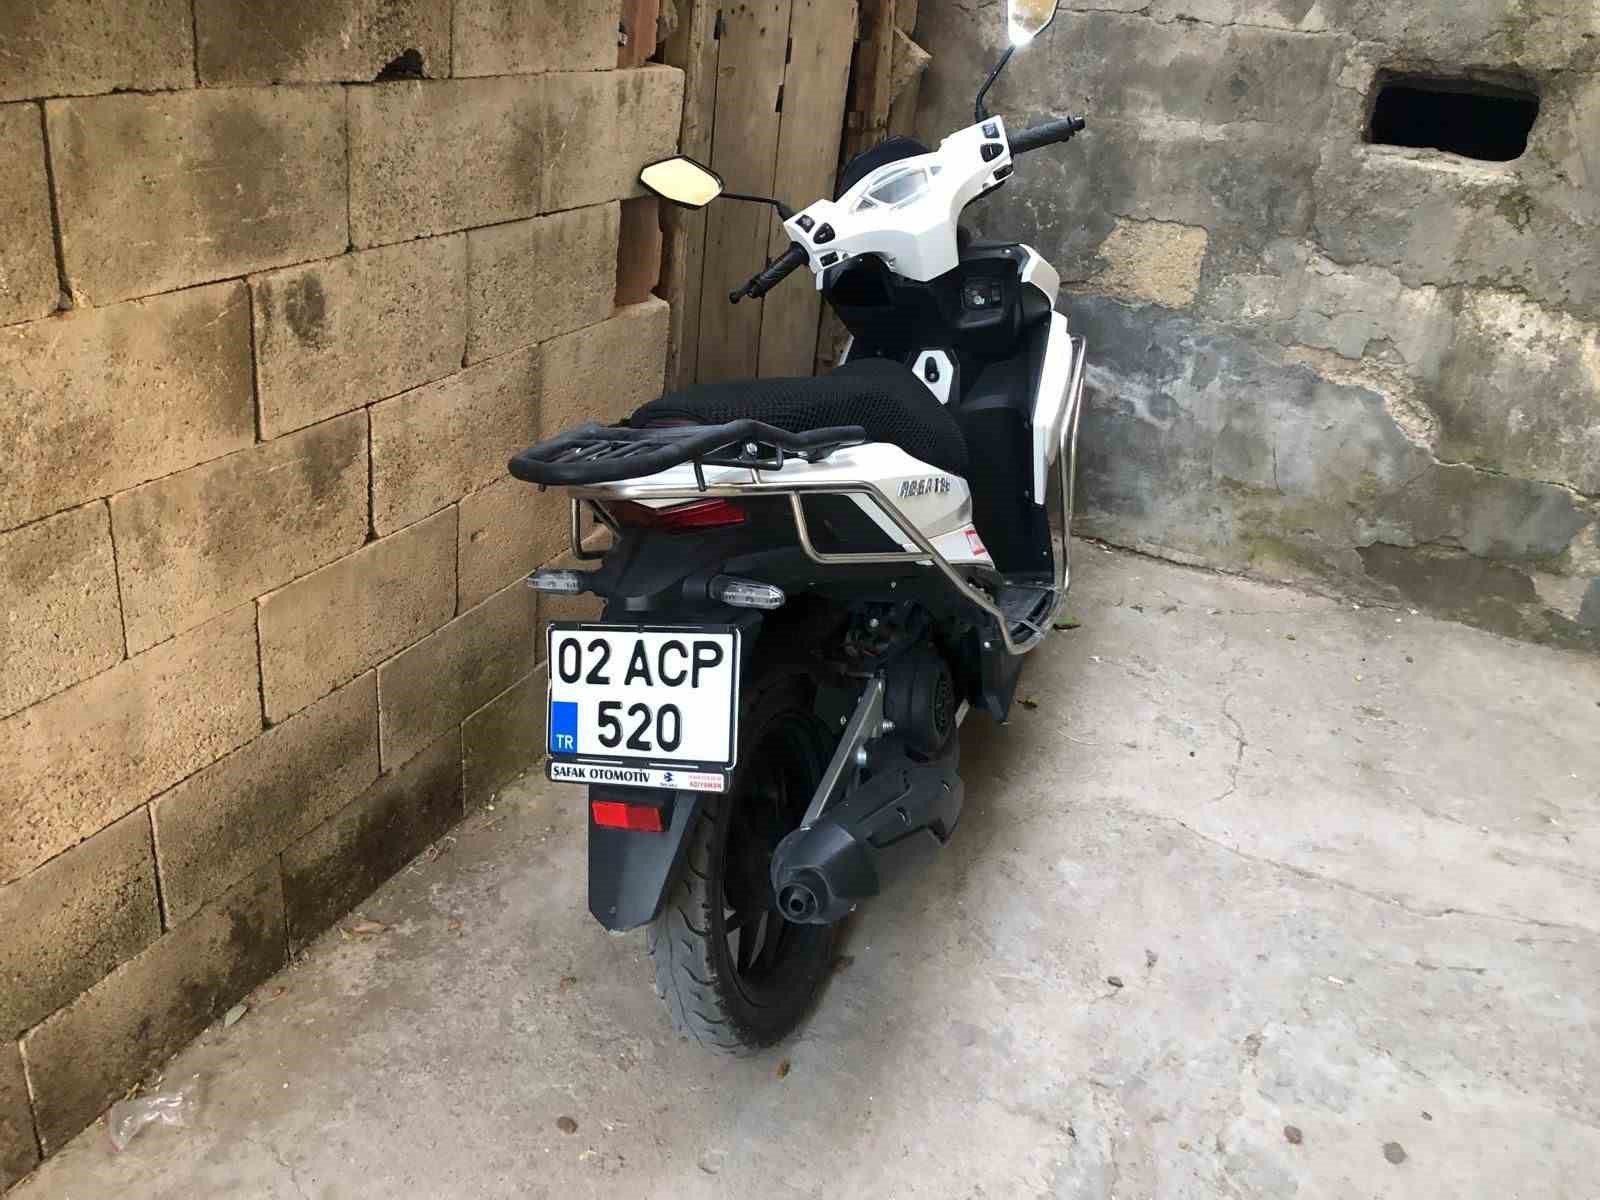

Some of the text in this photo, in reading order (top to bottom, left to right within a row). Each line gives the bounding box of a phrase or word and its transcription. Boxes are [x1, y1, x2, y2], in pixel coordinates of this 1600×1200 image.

[558, 637, 724, 688] 02 ACP
[556, 734, 574, 750] TR
[597, 701, 682, 752] 520
